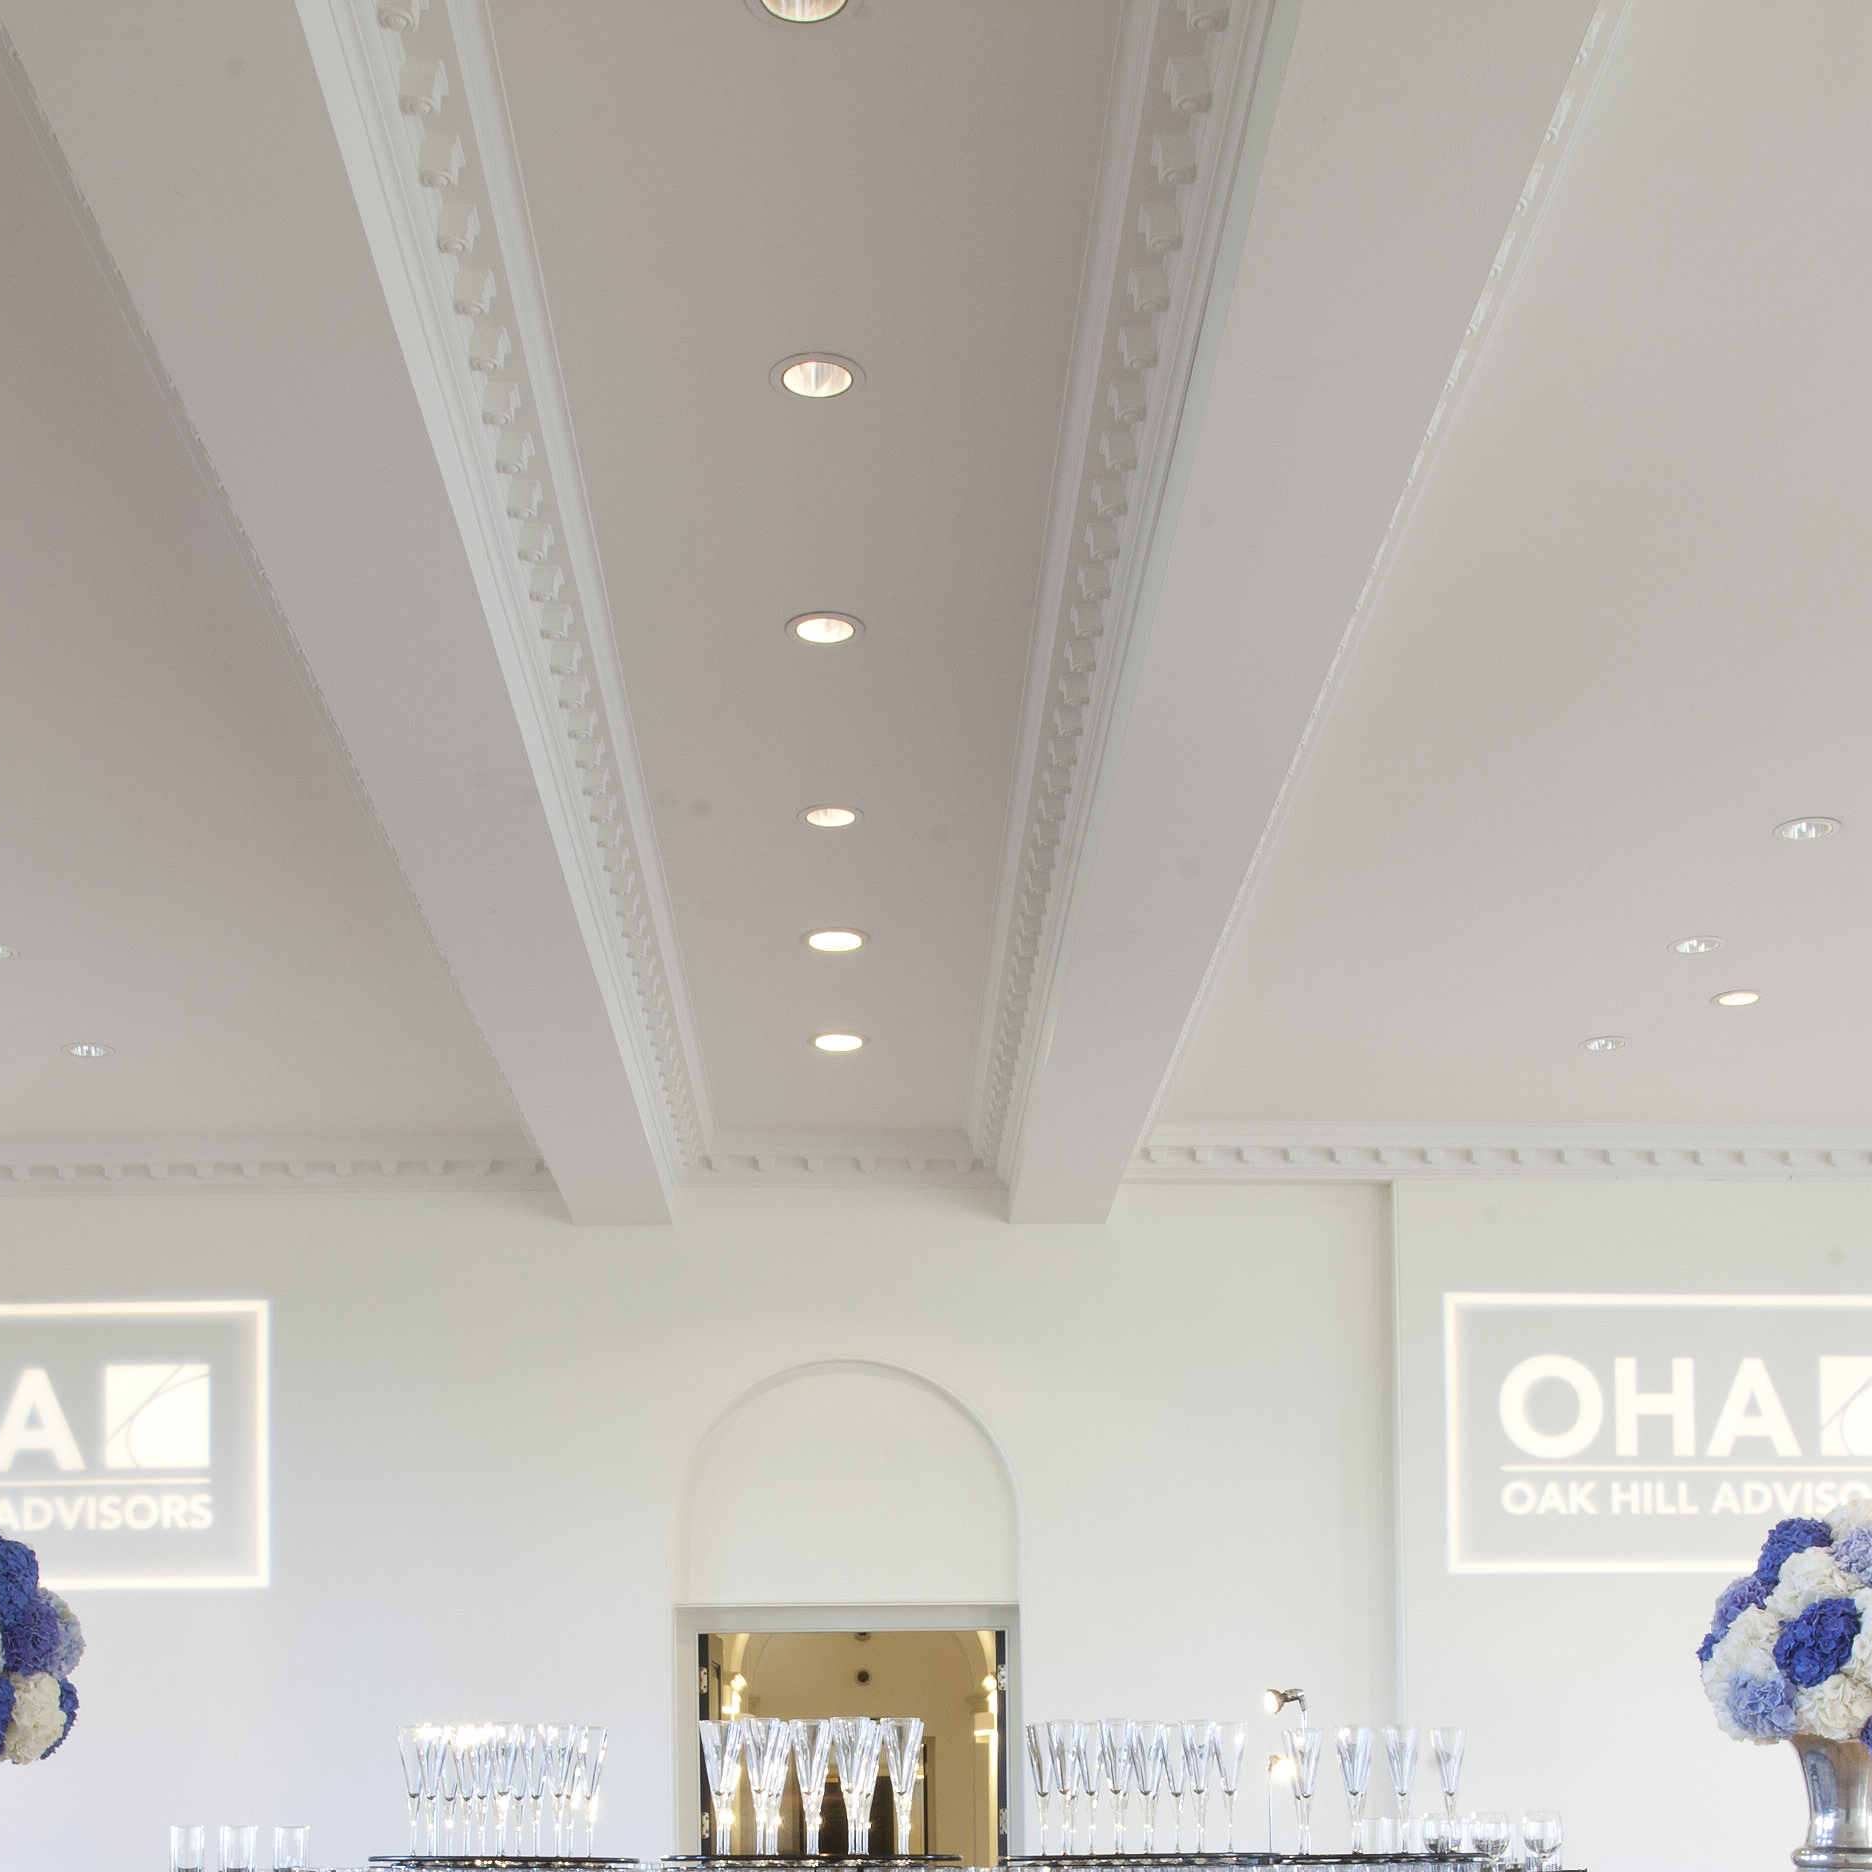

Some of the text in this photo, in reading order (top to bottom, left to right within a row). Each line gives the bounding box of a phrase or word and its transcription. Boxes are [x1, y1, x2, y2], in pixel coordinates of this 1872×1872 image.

[1499, 1355, 1802, 1459] OHA
[1502, 1481, 1598, 1515] OAK
[1611, 1481, 1700, 1514] HILL
